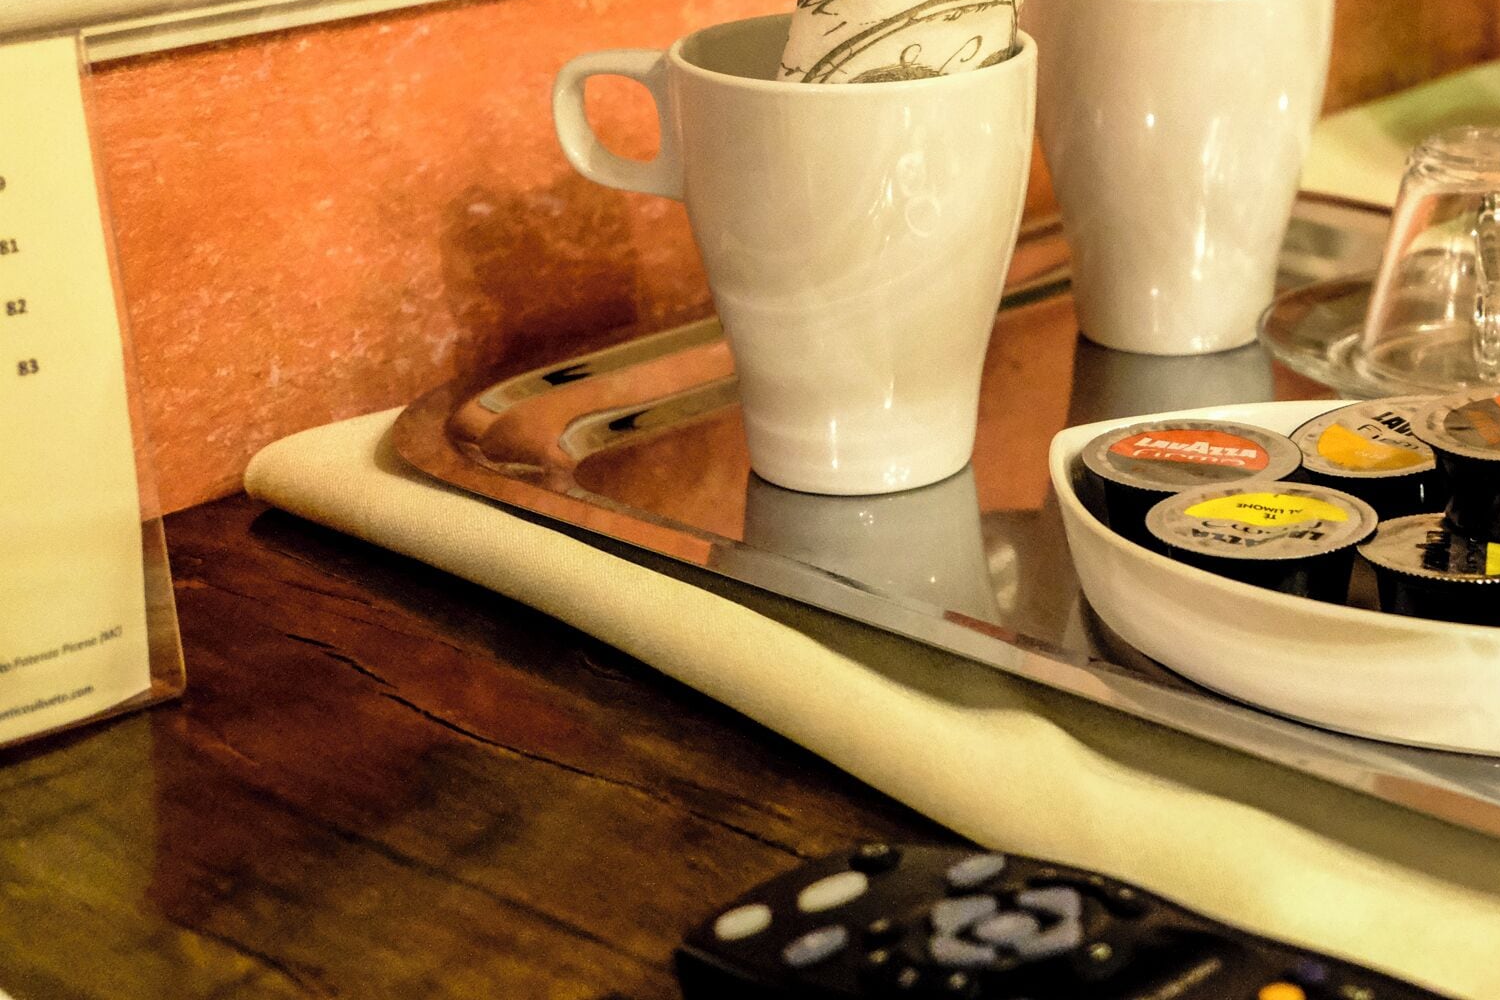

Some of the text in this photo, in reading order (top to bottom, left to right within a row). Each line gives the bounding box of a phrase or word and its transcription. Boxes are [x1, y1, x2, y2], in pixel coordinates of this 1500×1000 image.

[6, 299, 28, 316] 82
[18, 358, 39, 377] 83
[1134, 437, 1258, 459] LAVAZZA
[1235, 501, 1285, 516] LIMONE
